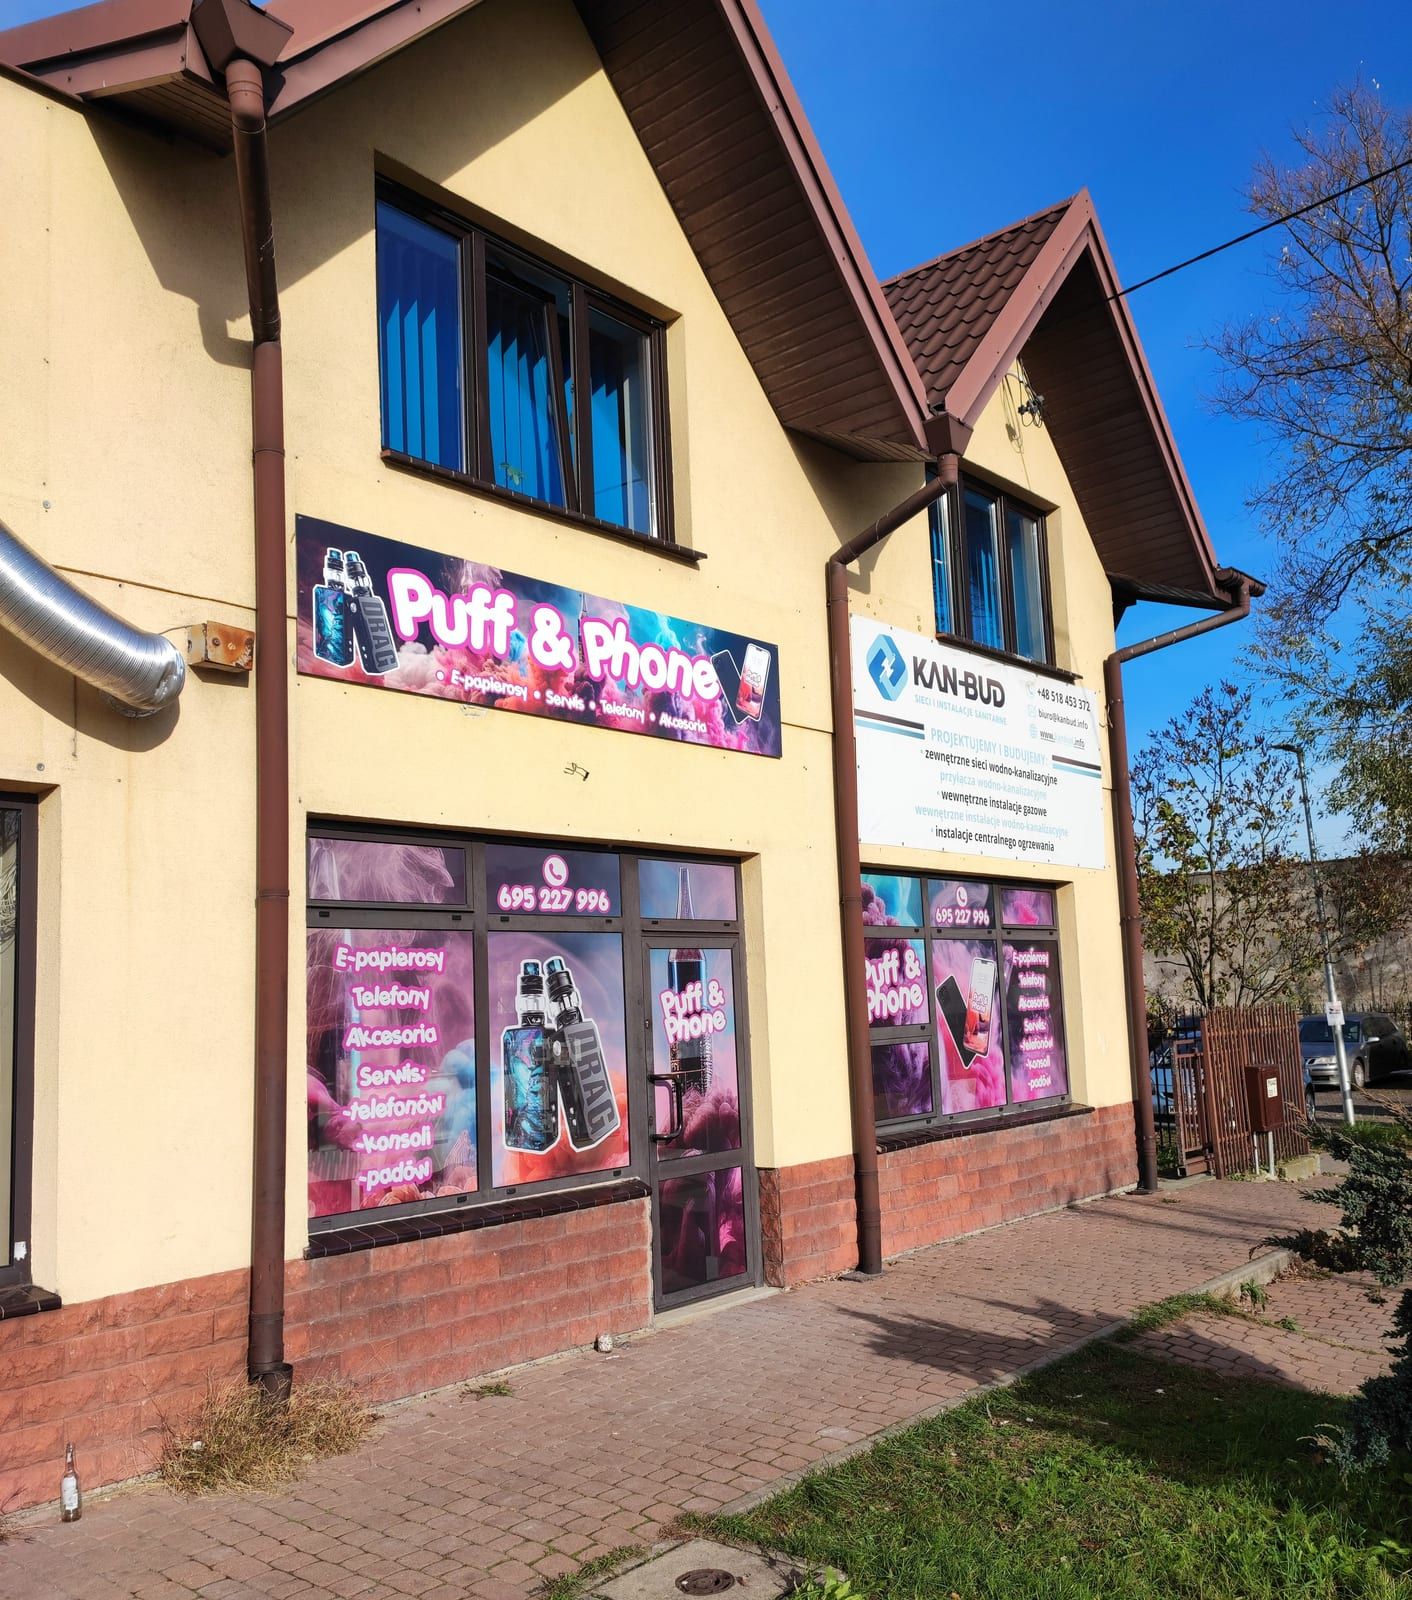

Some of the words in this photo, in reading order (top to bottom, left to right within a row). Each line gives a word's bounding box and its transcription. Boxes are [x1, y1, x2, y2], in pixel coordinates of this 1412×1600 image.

[360, 601, 395, 668] DRAG
[390, 571, 516, 656] Puff
[531, 606, 574, 670] &
[583, 621, 720, 700] Phone
[912, 655, 1006, 709] KAN-BUD
[450, 669, 528, 700] E-papierosy
[545, 691, 585, 712] Serwis
[600, 699, 645, 724] Telefony
[658, 712, 707, 733] Akcesoria
[914, 694, 932, 706] SIECI
[936, 699, 974, 717] INSTALACJE
[974, 709, 1008, 726] SANITARNE
[1037, 687, 1050, 700] +48
[1051, 690, 1064, 704] 518
[1065, 695, 1077, 708] 453
[1078, 698, 1091, 712] 372
[1038, 708, 1089, 730] biuro@kanbud.info
[930, 727, 997, 754] PROJEKTUJEMY
[925, 749, 970, 767] zewnętrzne
[971, 757, 988, 771] sieci
[988, 760, 1058, 787] wodno-kanalizacyjne
[940, 771, 976, 787] przyłącza
[977, 777, 1047, 801] wodno-kanalizacyjne
[941, 790, 988, 807] wewnętrzne
[989, 796, 1022, 814] instalacje
[1023, 805, 1048, 817] gazowe
[915, 805, 964, 823] wewnętrzne
[965, 810, 1001, 828] instalacje
[1001, 816, 1069, 838] wodno-kanalizacyjne
[935, 825, 973, 843] instalacje
[974, 831, 1017, 850] centralnego
[1017, 837, 1055, 852] ogrzewania
[500, 886, 536, 910] 695
[539, 887, 573, 911] 227
[576, 890, 610, 912] 996
[936, 908, 953, 924] 695
[954, 909, 971, 925] 227
[973, 909, 990, 926] 996
[336, 946, 444, 971] E-papierosy
[904, 949, 921, 980] &
[351, 986, 430, 1010] Telefony
[660, 982, 703, 1018] Puff
[708, 980, 725, 1007] &
[346, 1023, 437, 1048] Akcesoria
[359, 1066, 426, 1087] Serwis:
[567, 1029, 615, 1135] DRAG
[343, 1093, 443, 1120] -telefonów
[355, 1126, 431, 1153] -konsoli
[358, 1159, 430, 1190] -padów
